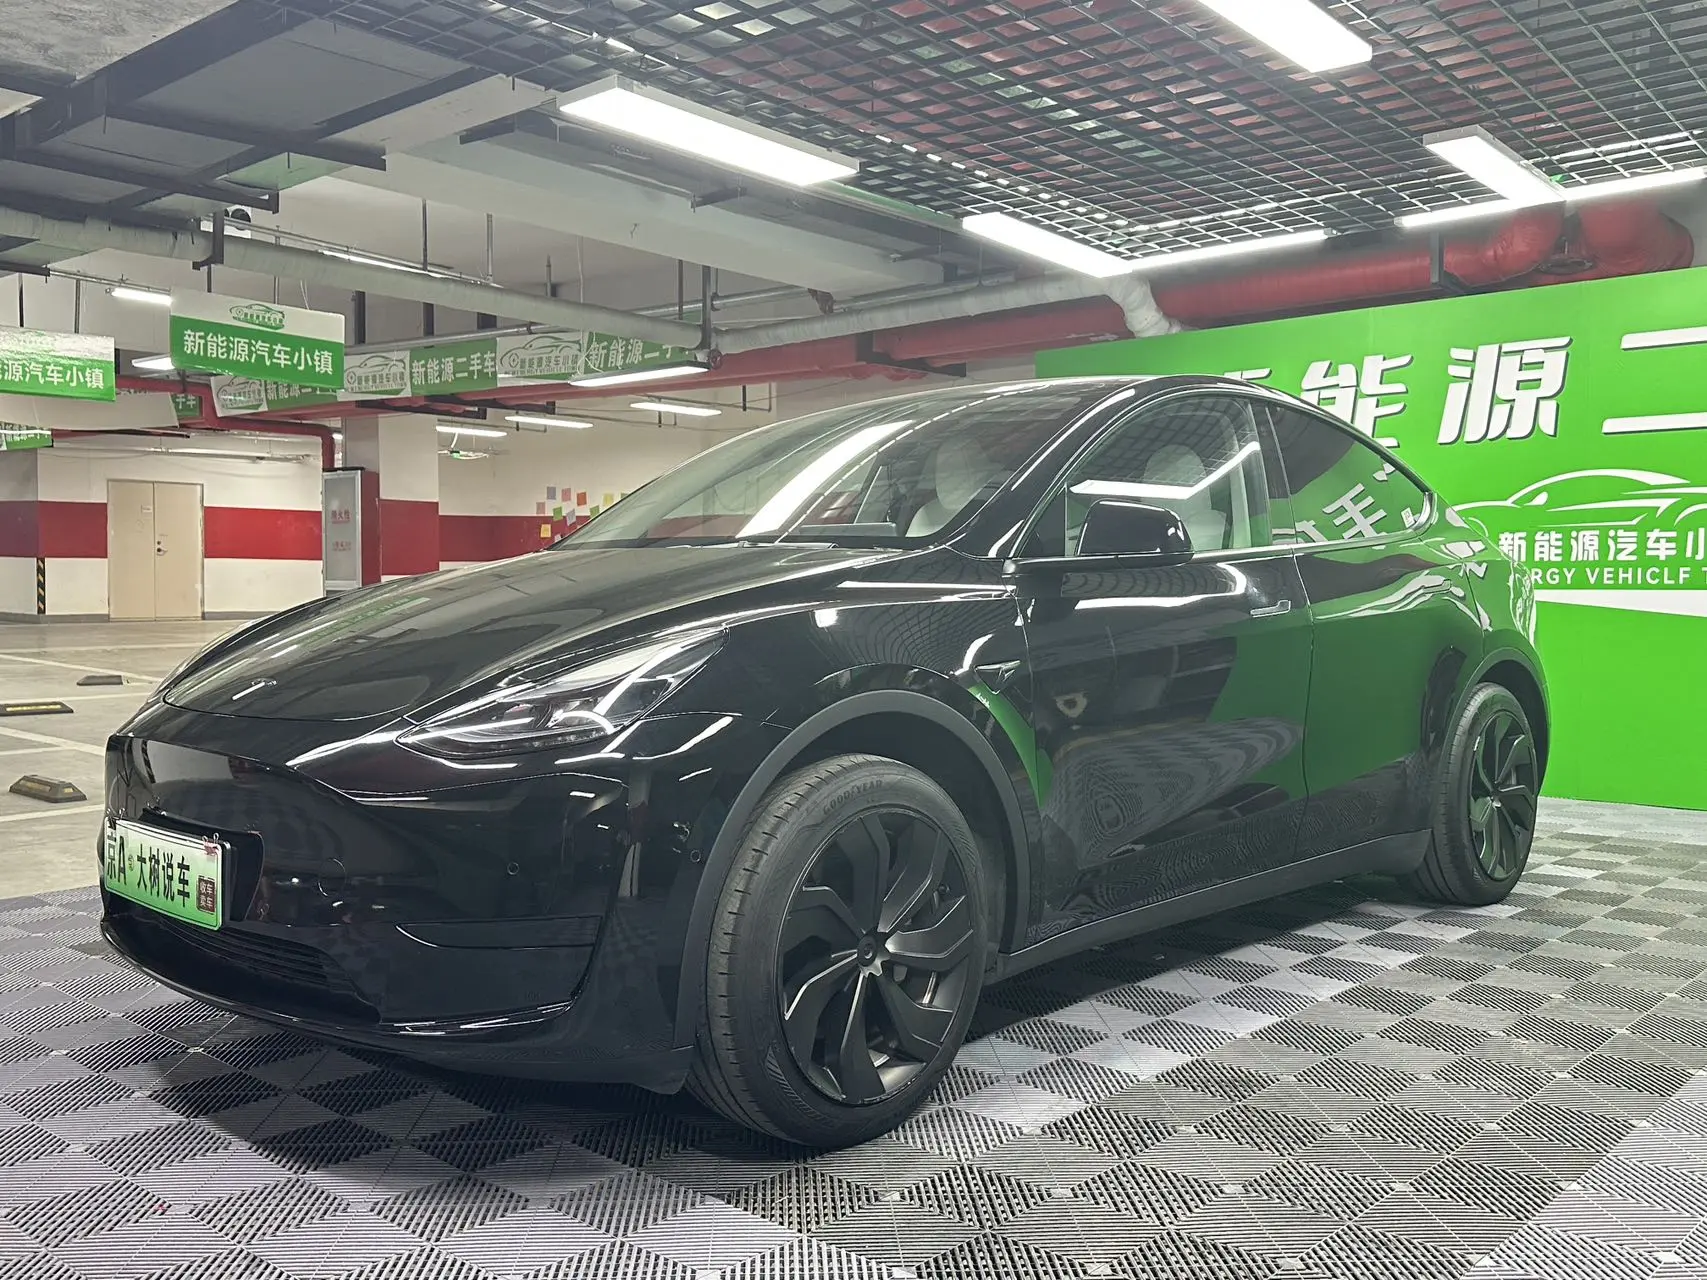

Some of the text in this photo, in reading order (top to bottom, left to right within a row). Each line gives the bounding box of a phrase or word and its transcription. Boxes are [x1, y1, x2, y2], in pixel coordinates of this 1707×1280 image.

[183, 329, 333, 375] 新能源汽车小镇
[411, 350, 496, 385] 新能源二手车
[0, 360, 104, 390] 源汽车小镇
[1224, 327, 1707, 449] 能源二
[1532, 567, 1577, 585] RGY
[823, 780, 882, 814] GOODYEAR
